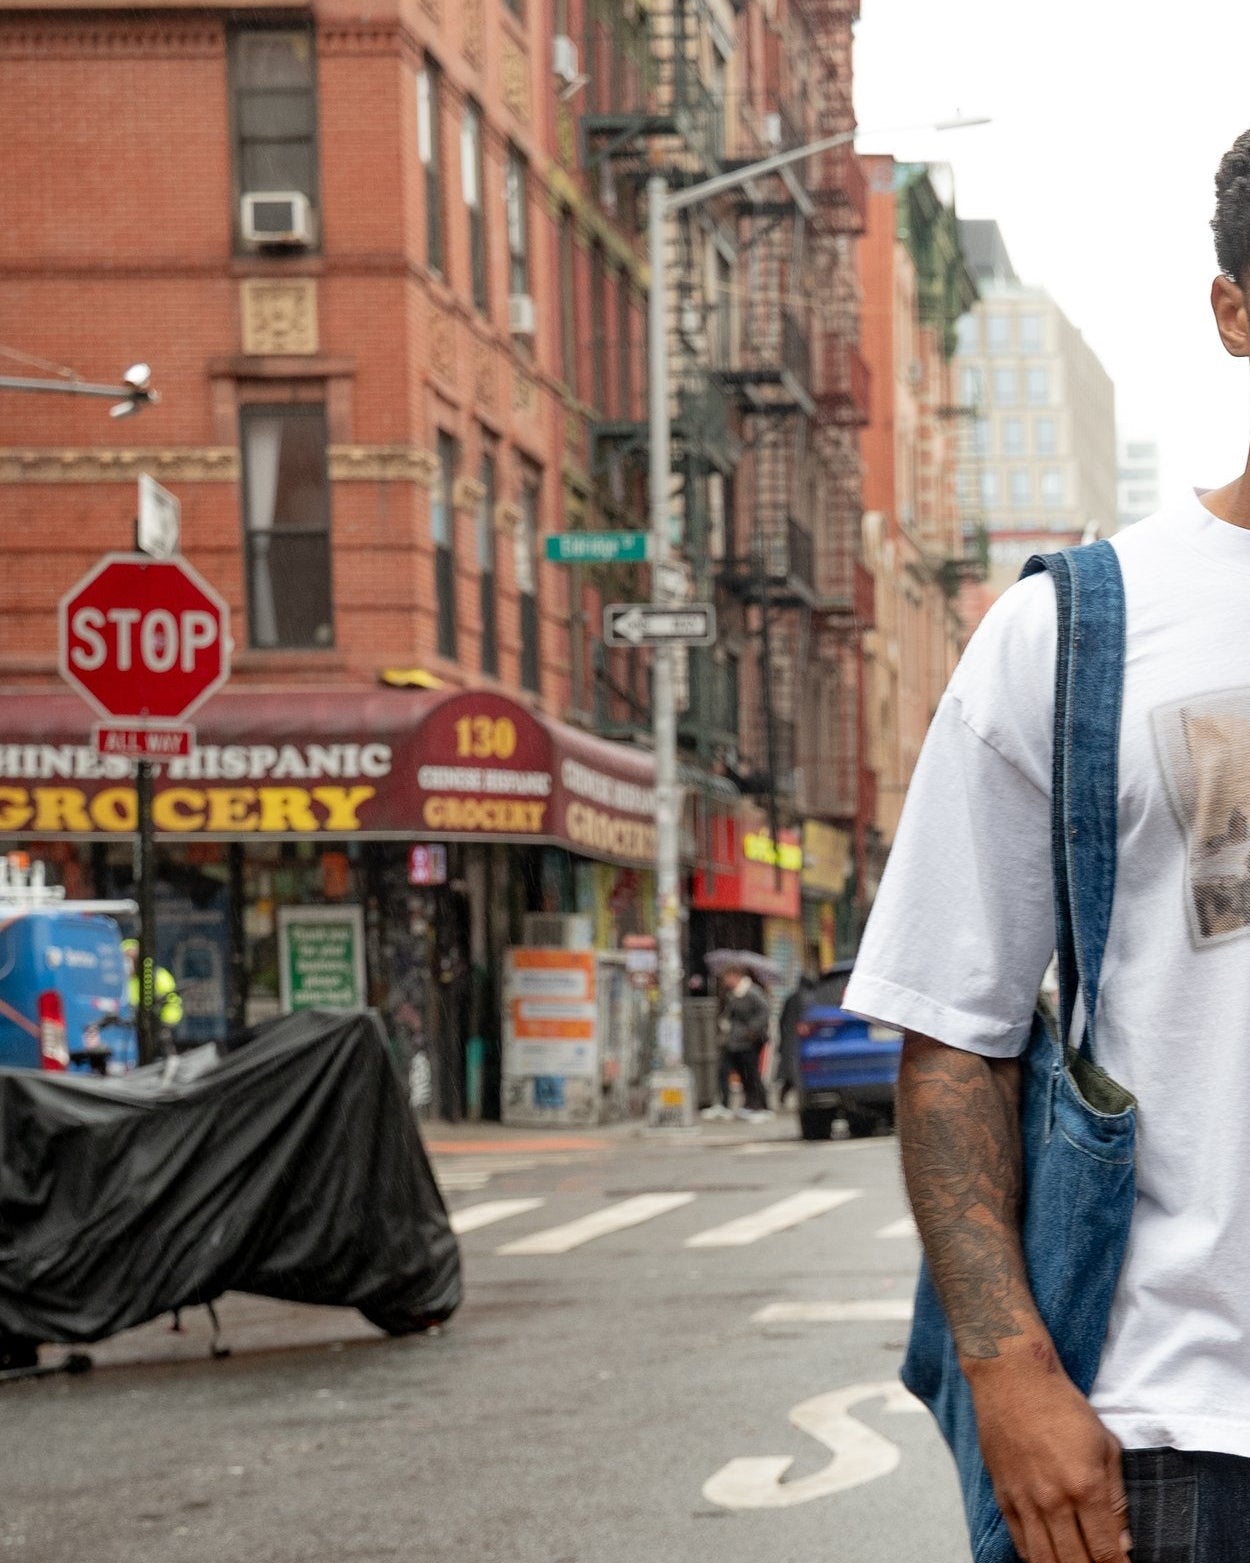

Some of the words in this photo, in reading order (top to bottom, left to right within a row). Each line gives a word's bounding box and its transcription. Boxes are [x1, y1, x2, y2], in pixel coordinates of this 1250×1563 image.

[70, 606, 218, 674] STOP
[104, 732, 142, 753] ALL
[145, 733, 183, 754] WAY
[456, 714, 517, 760] 130
[0, 744, 161, 780] HINES
[167, 742, 392, 780] HISPANIC
[0, 785, 377, 833] GROCERY
[423, 796, 547, 834] GROCERY
